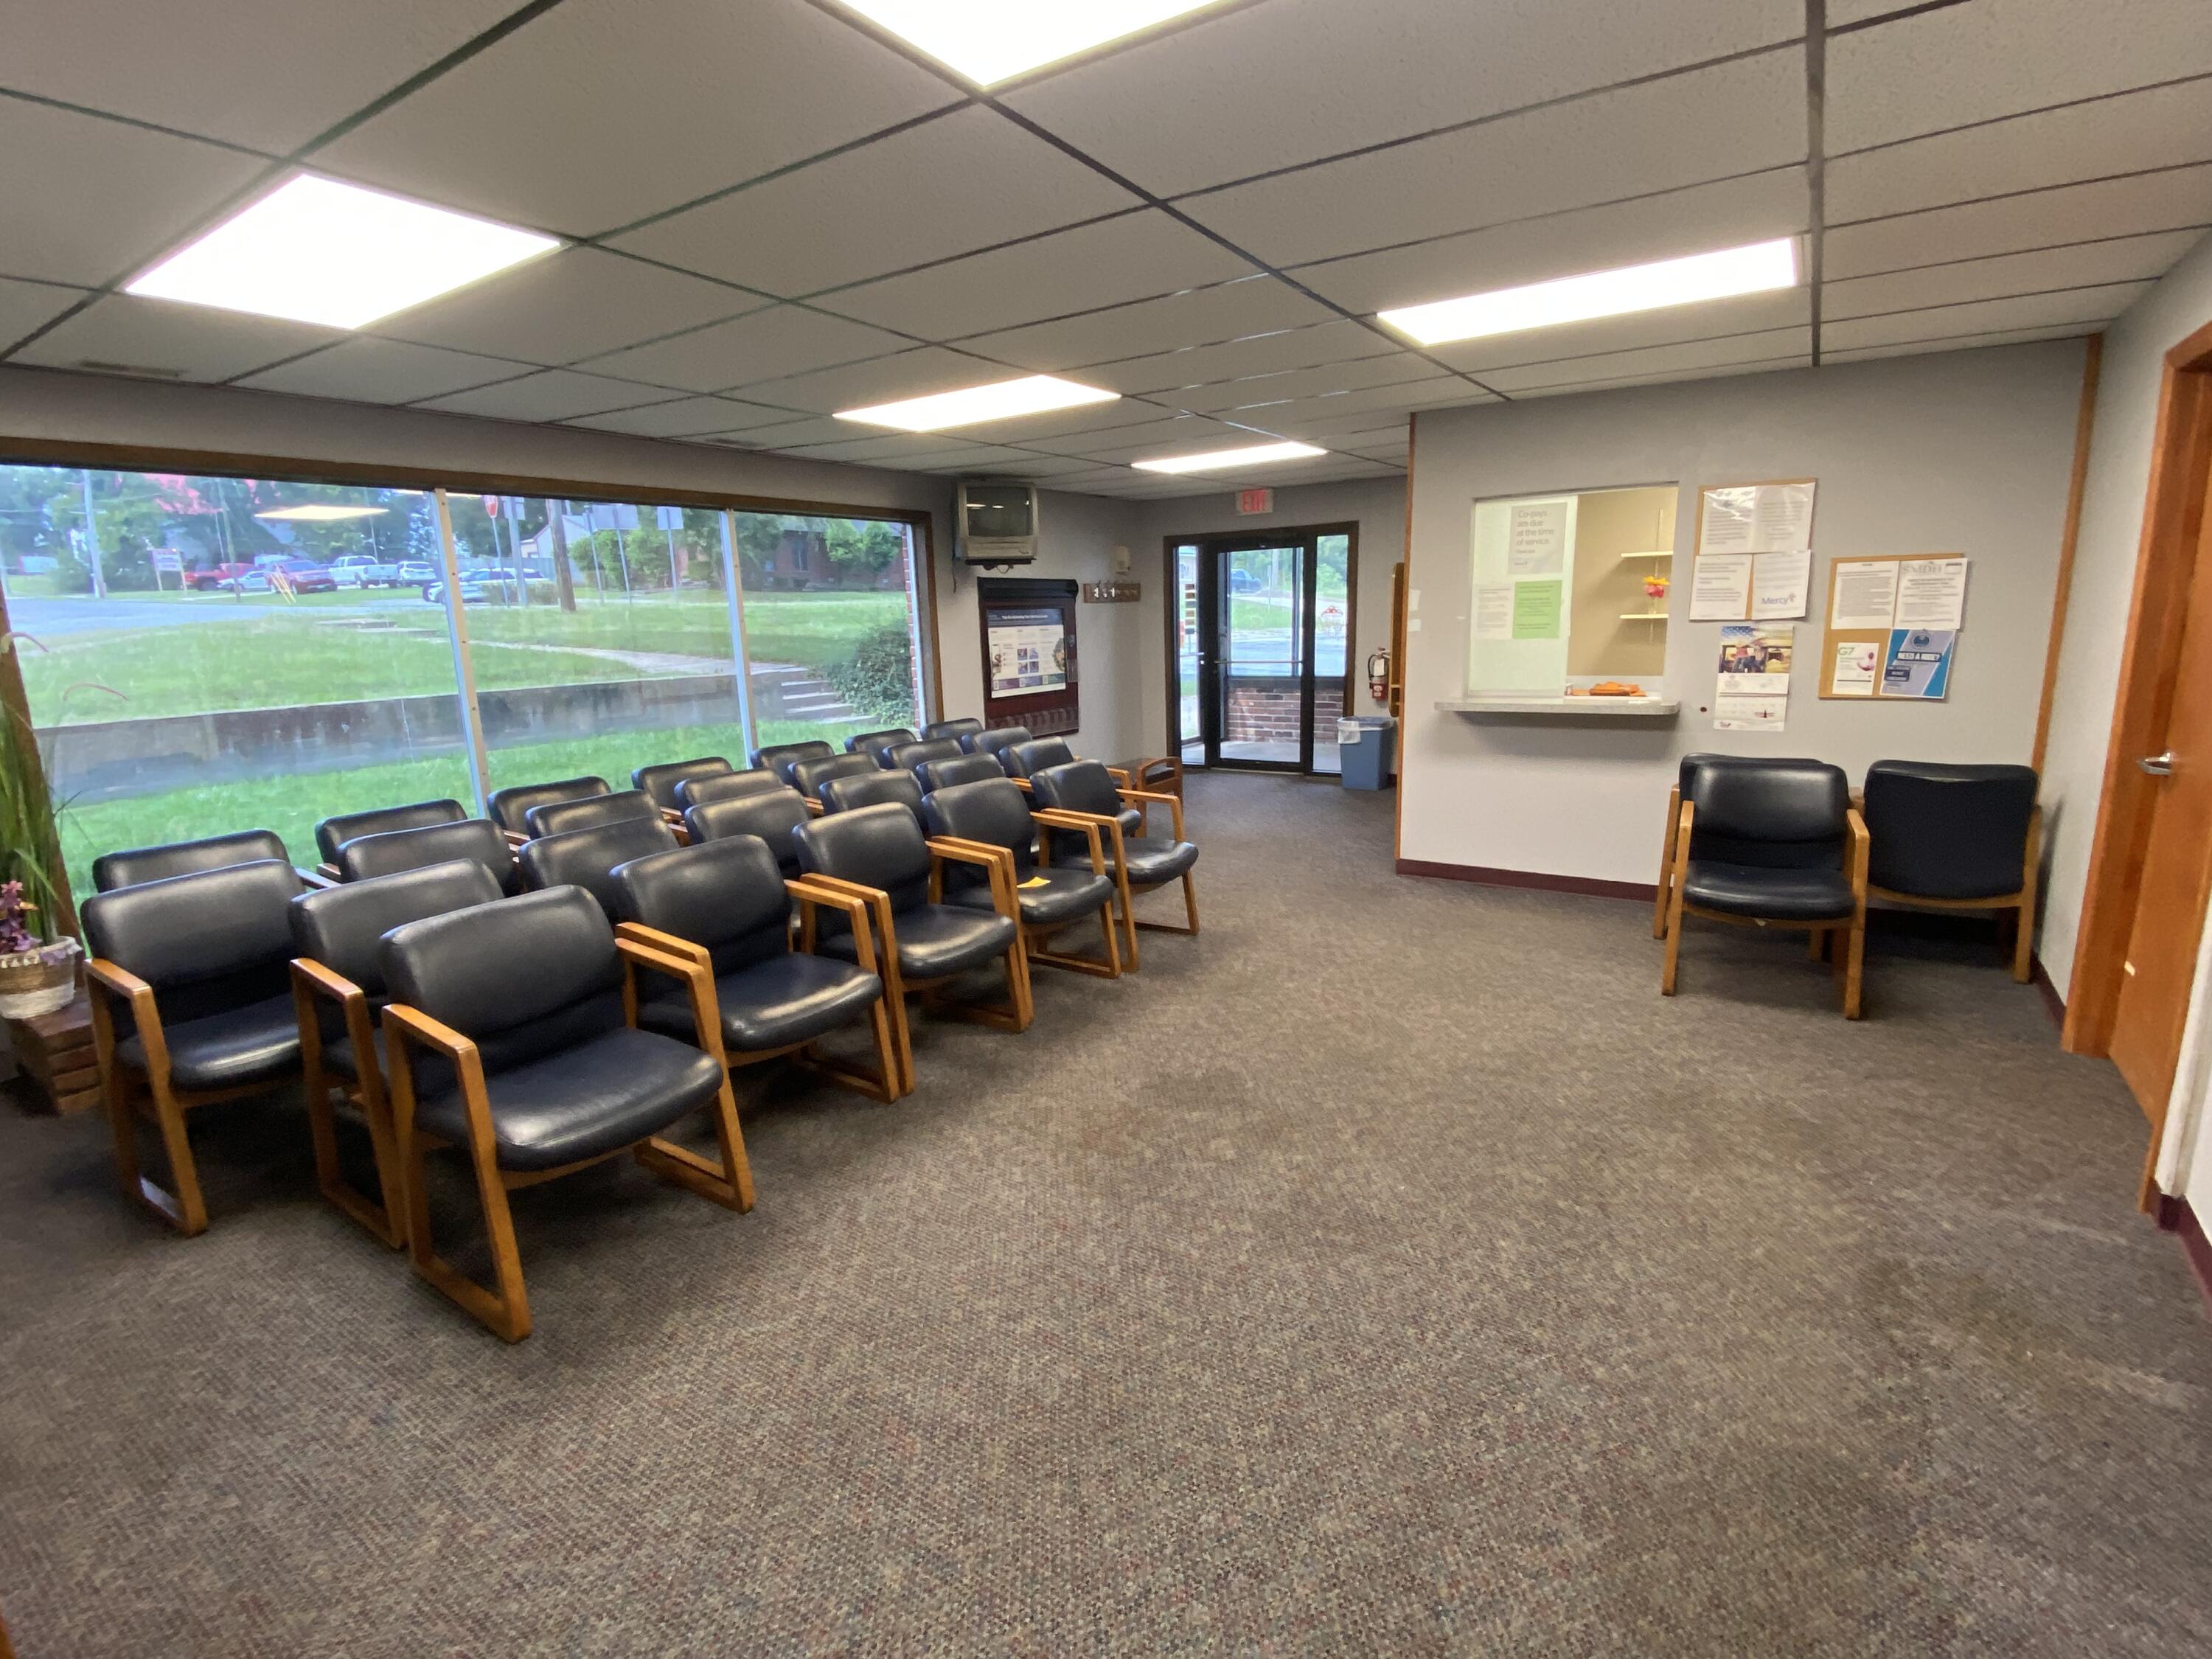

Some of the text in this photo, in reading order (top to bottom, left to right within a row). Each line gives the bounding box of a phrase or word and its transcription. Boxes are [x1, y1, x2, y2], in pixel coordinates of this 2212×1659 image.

[1242, 490, 1267, 513] EXIT
[1517, 509, 1548, 518] Co-pays
[1761, 597, 1789, 605] Mercy
